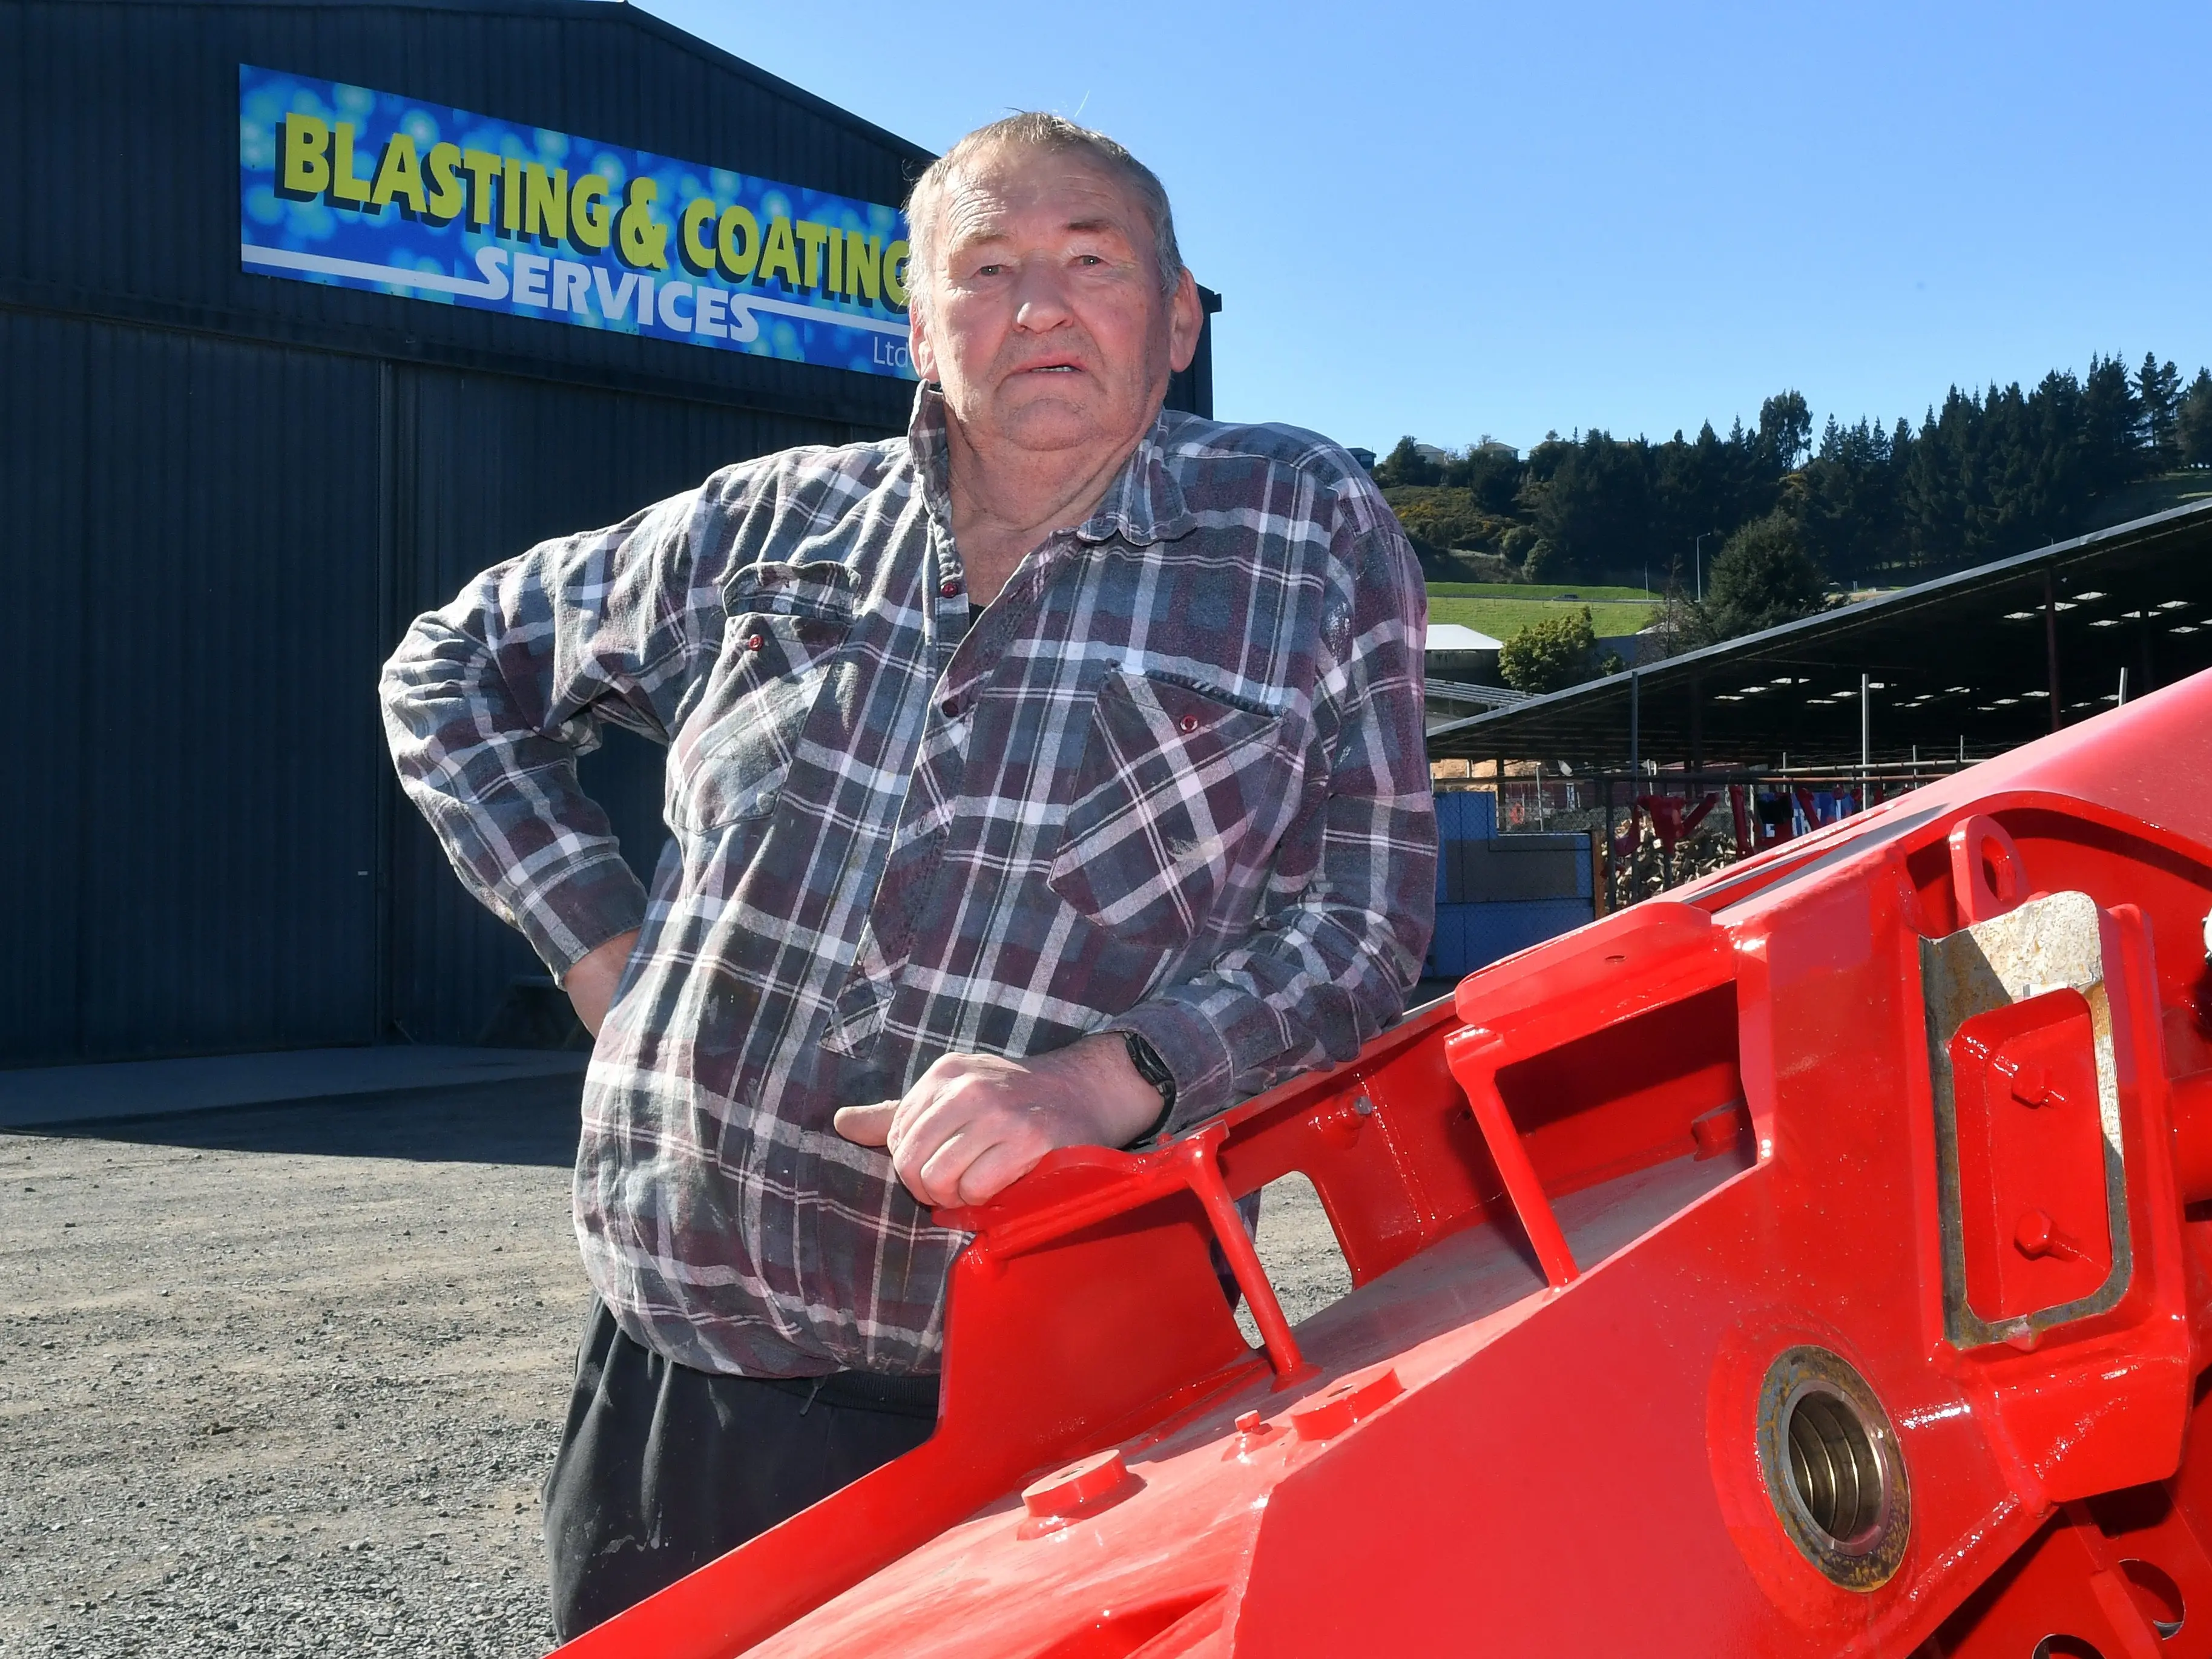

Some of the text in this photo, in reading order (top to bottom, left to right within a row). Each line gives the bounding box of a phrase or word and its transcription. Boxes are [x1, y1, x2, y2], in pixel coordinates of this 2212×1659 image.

[282, 113, 909, 307] BLASTING & COATING
[473, 246, 759, 343] SERVICES
[873, 336, 908, 369] Ltd
